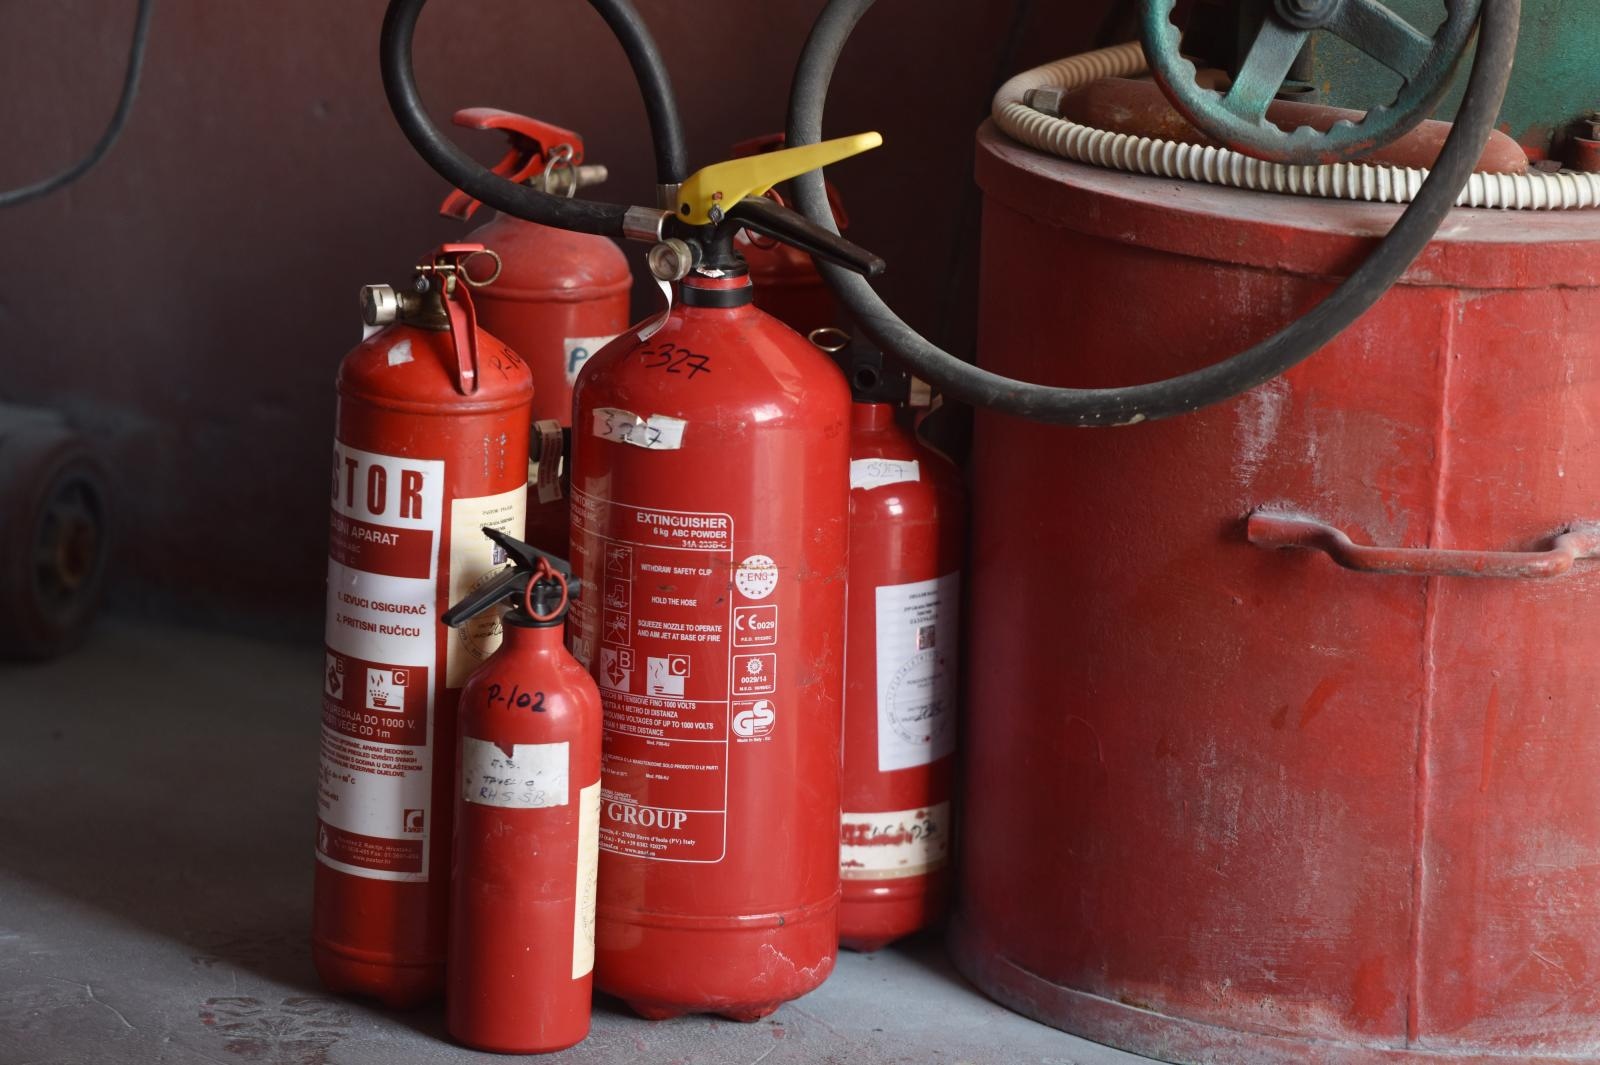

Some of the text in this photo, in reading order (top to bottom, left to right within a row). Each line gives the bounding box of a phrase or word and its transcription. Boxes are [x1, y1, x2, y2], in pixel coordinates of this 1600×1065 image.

[636, 511, 728, 530] EXTINGUISHER
[351, 526, 399, 546] APARAT
[653, 527, 727, 539] 6 kg ABC POWDER
[640, 563, 713, 577] WITHDRAW SAFETY CLIP
[343, 594, 369, 609] IZVUCI
[370, 601, 427, 615] OSIGURAČ
[651, 596, 667, 604] HOLD
[680, 599, 697, 607] HOSE
[343, 615, 377, 632] PRITISNI
[379, 624, 421, 637] RUČICU
[637, 619, 722, 632] SQUEEZE NOZZLE TO OPERATE
[637, 629, 649, 638] AND
[649, 631, 660, 639] AIM
[661, 632, 671, 640] JET
[680, 633, 696, 641] BASE
[697, 633, 706, 641] OF
[707, 634, 721, 642] FIRE
[620, 652, 631, 668] B
[671, 658, 687, 675] C
[394, 671, 406, 685] C
[487, 684, 547, 712] P-102
[651, 708, 678, 718] DISTANZA
[677, 702, 696, 710] VOLTS
[363, 714, 378, 725] DO
[381, 718, 405, 728] 1000
[626, 714, 653, 726] VOLTAGES
[694, 722, 714, 730] VOLTS
[734, 700, 774, 736] GS
[359, 725, 373, 736] OD
[376, 728, 391, 738] 1m
[637, 726, 664, 736] DISTANCE
[607, 802, 688, 830] GROUP
